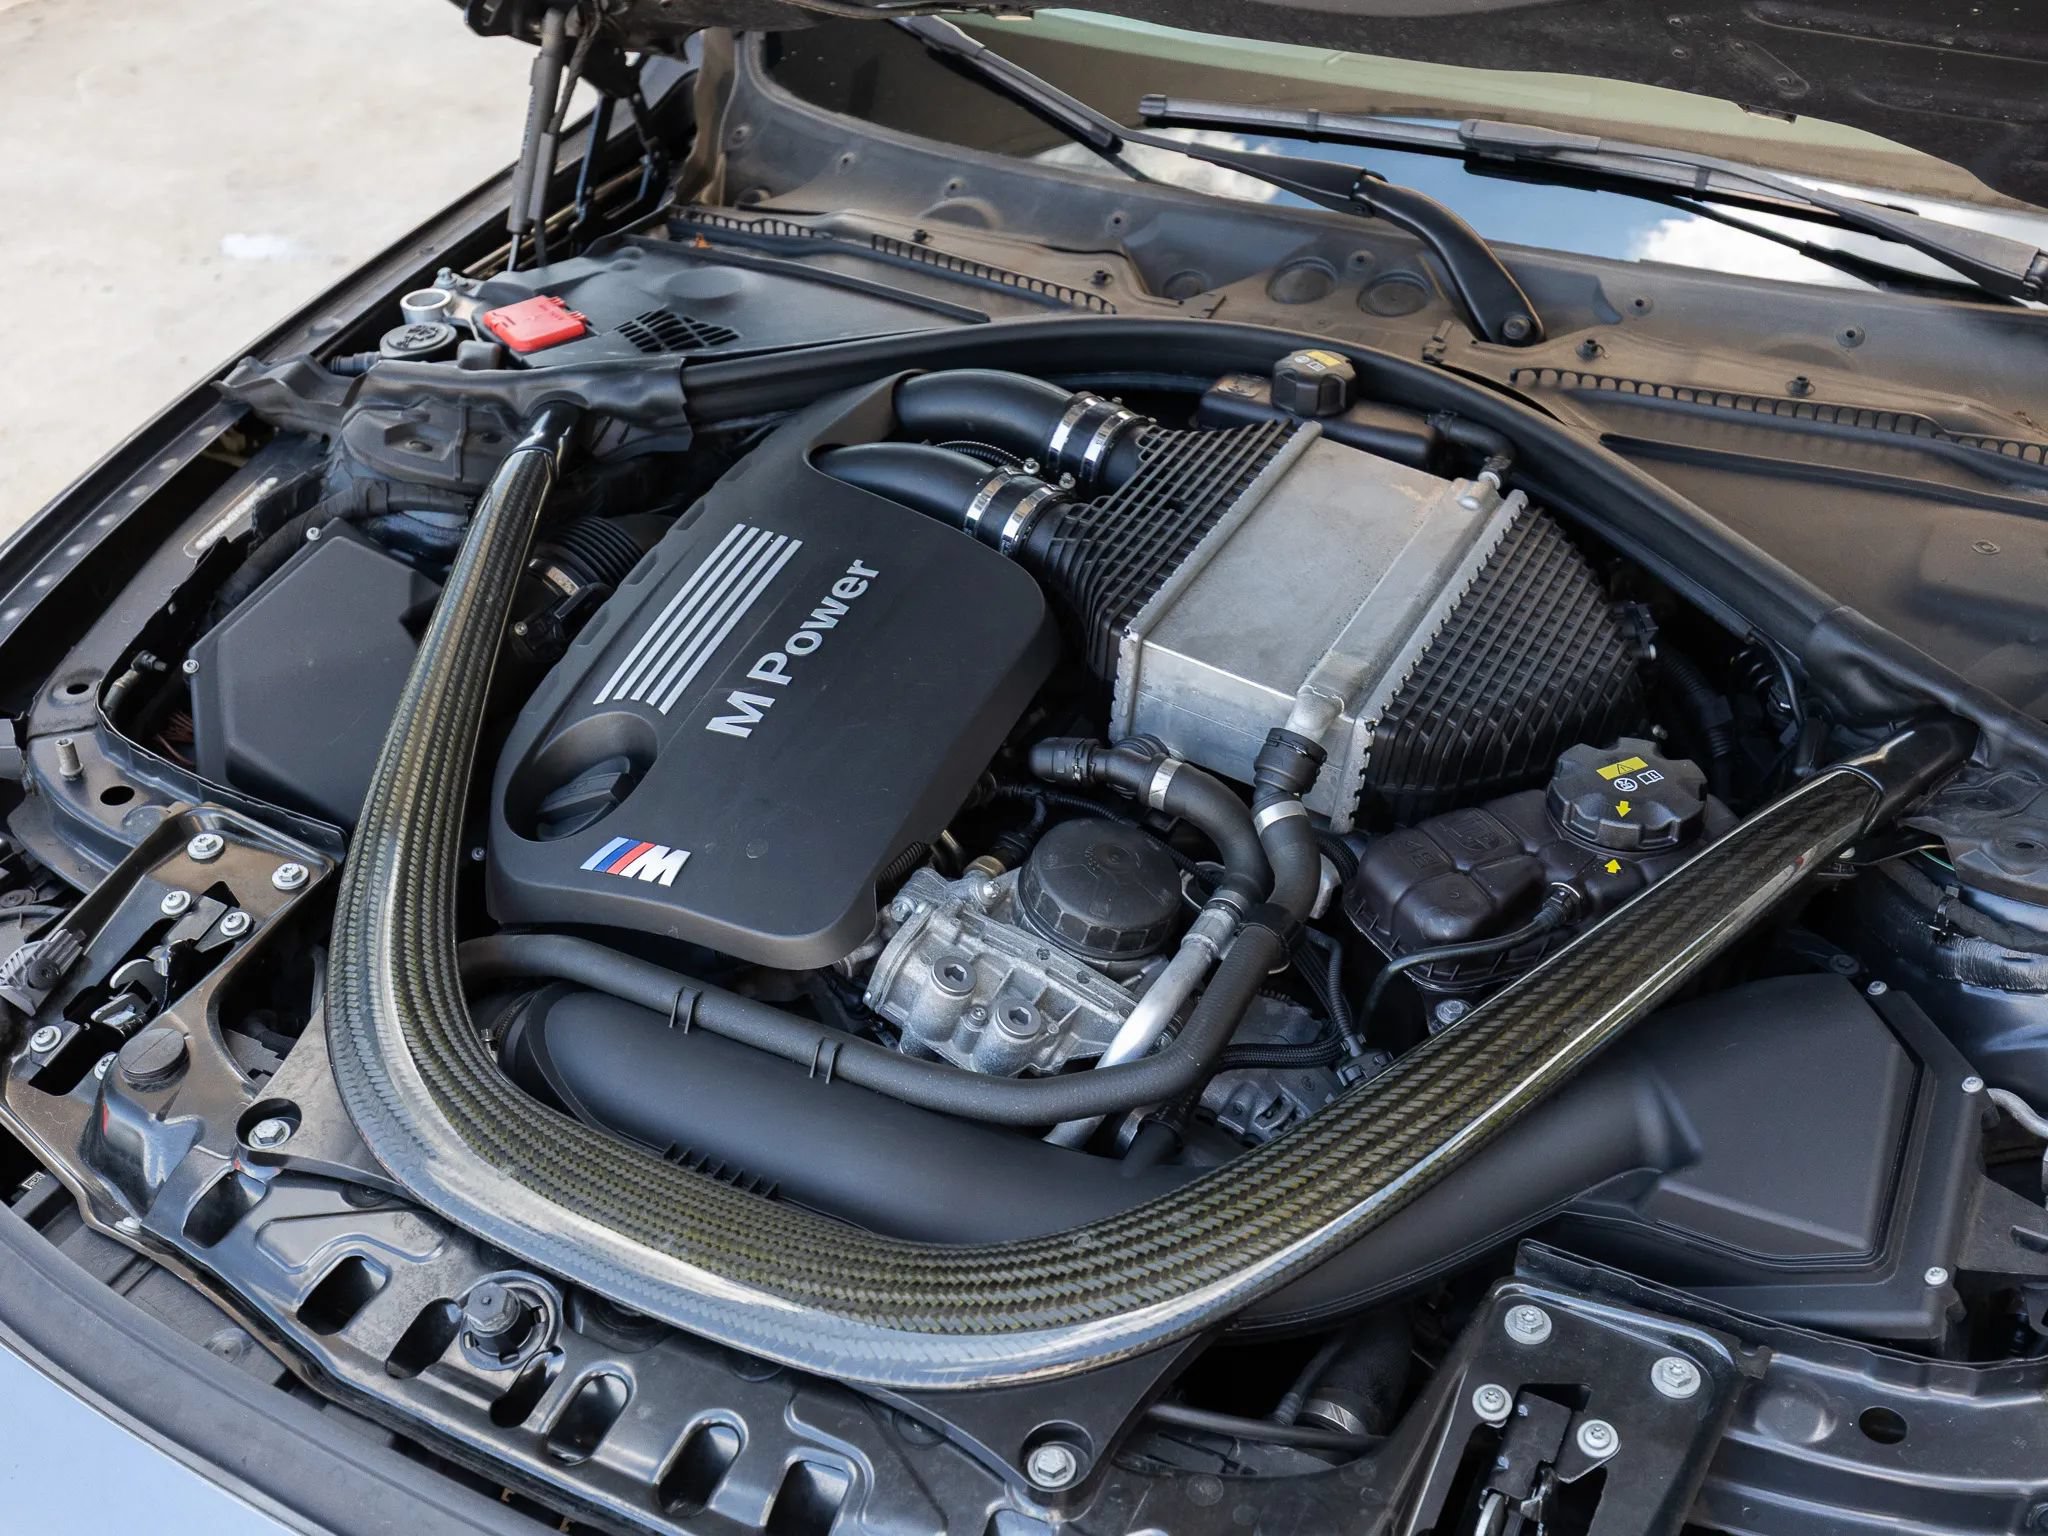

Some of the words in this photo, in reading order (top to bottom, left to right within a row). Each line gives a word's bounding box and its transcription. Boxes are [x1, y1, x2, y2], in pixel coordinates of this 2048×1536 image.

[705, 690, 775, 738] M
[746, 559, 881, 686] Power
[619, 844, 692, 888] M
